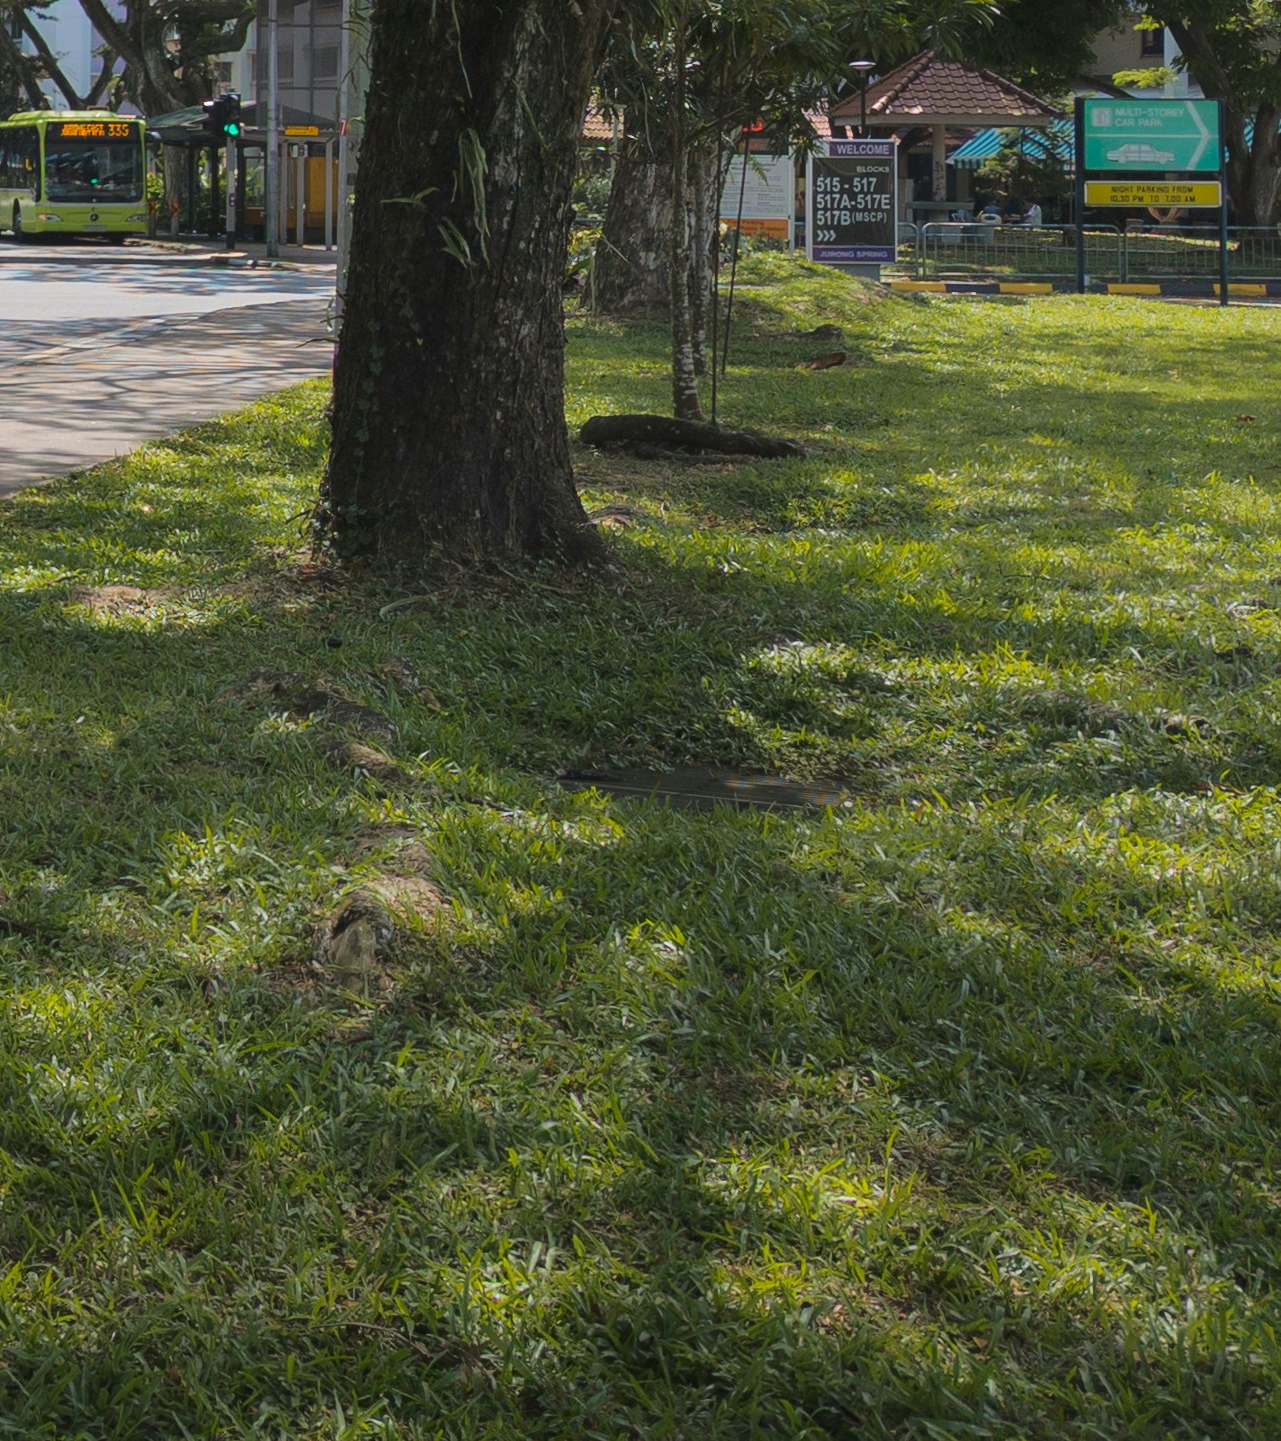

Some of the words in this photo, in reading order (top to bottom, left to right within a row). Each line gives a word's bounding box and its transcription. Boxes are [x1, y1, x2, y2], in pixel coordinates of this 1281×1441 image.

[1115, 108, 1185, 117] MULTI-STOREY
[1115, 118, 1135, 127] CAR
[1138, 118, 1163, 127] PARK
[836, 144, 890, 155] WELCOME
[856, 165, 890, 173] BLOCKS
[816, 177, 840, 193] 515
[852, 177, 877, 193] 517
[1111, 186, 1134, 194] NIGHT
[1136, 186, 1170, 194] PARKING
[1172, 186, 1194, 194] FROM
[816, 193, 891, 209] 517A-517E
[1132, 195, 1144, 203] PM
[1150, 195, 1160, 203] TO
[1184, 195, 1196, 203] AM
[819, 250, 855, 258] JURONG
[856, 250, 888, 258] SPRING
